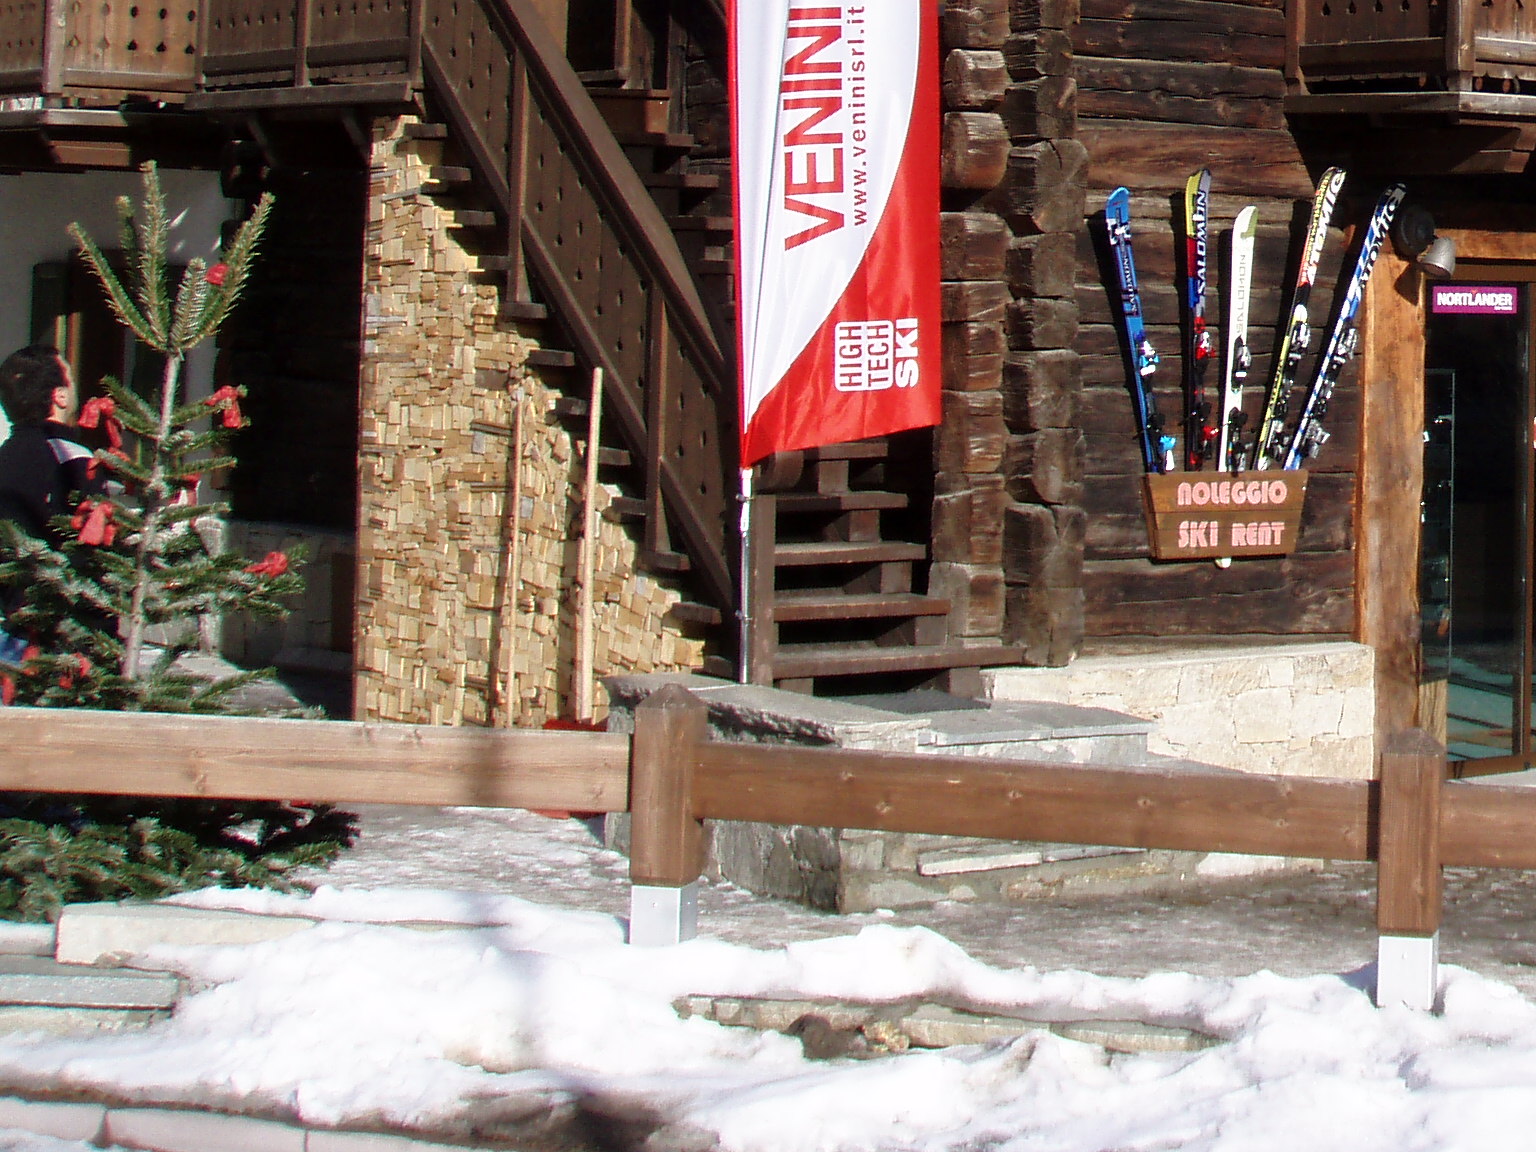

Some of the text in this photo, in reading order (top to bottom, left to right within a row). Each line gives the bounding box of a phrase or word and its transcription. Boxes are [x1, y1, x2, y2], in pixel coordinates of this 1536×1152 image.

[780, 6, 845, 250] VENINI
[847, 6, 867, 226] www.veninisrl.it
[1236, 254, 1247, 334] SALOMON
[1436, 292, 1513, 306] NORTLANDER
[838, 325, 863, 387] HIGH
[867, 324, 890, 387] TECH
[895, 317, 919, 388] SKI
[1178, 480, 1288, 506] NOLEGGIO
[1178, 521, 1285, 548] SKI RENT
